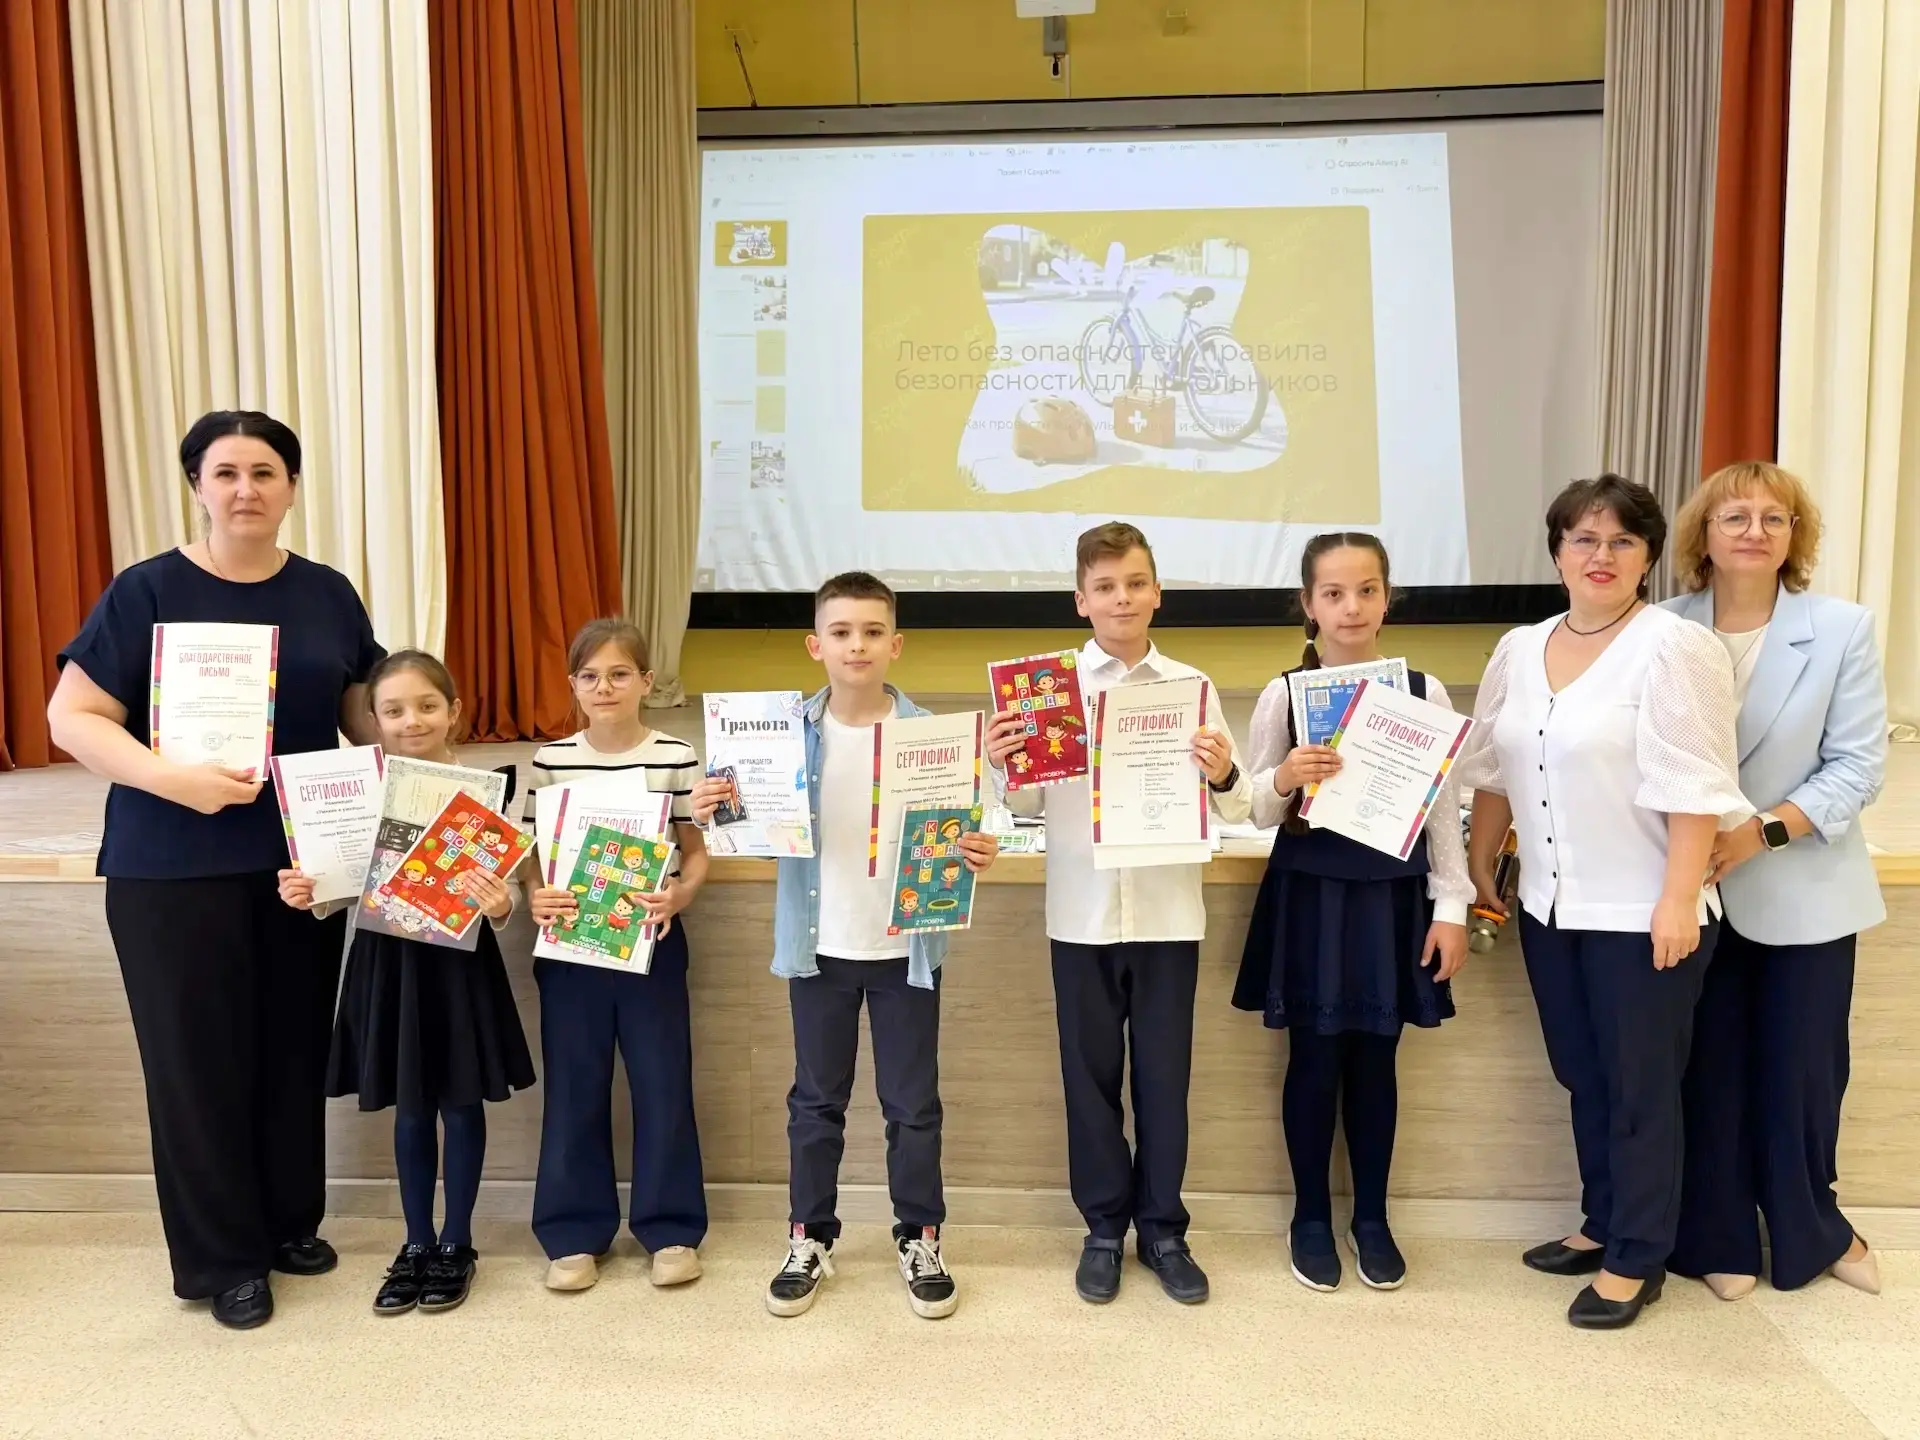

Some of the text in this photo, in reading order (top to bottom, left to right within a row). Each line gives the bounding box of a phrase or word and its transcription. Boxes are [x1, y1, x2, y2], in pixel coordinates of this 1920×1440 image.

[896, 340, 958, 362] Лето
[968, 340, 1013, 362] без
[894, 368, 1084, 391] безопасности
[178, 652, 252, 664] БЛАГОДАРСТВЕННОЕ
[199, 666, 230, 678] ПИСЬМО
[720, 717, 790, 735] Грамота
[1118, 712, 1184, 733] СЕРТИФИКАТ
[1366, 713, 1436, 752] СЕРТИФИКАТ
[896, 746, 961, 769] СЕРТИФИКАТ
[300, 780, 365, 802] СЕРТИФИКАТ
